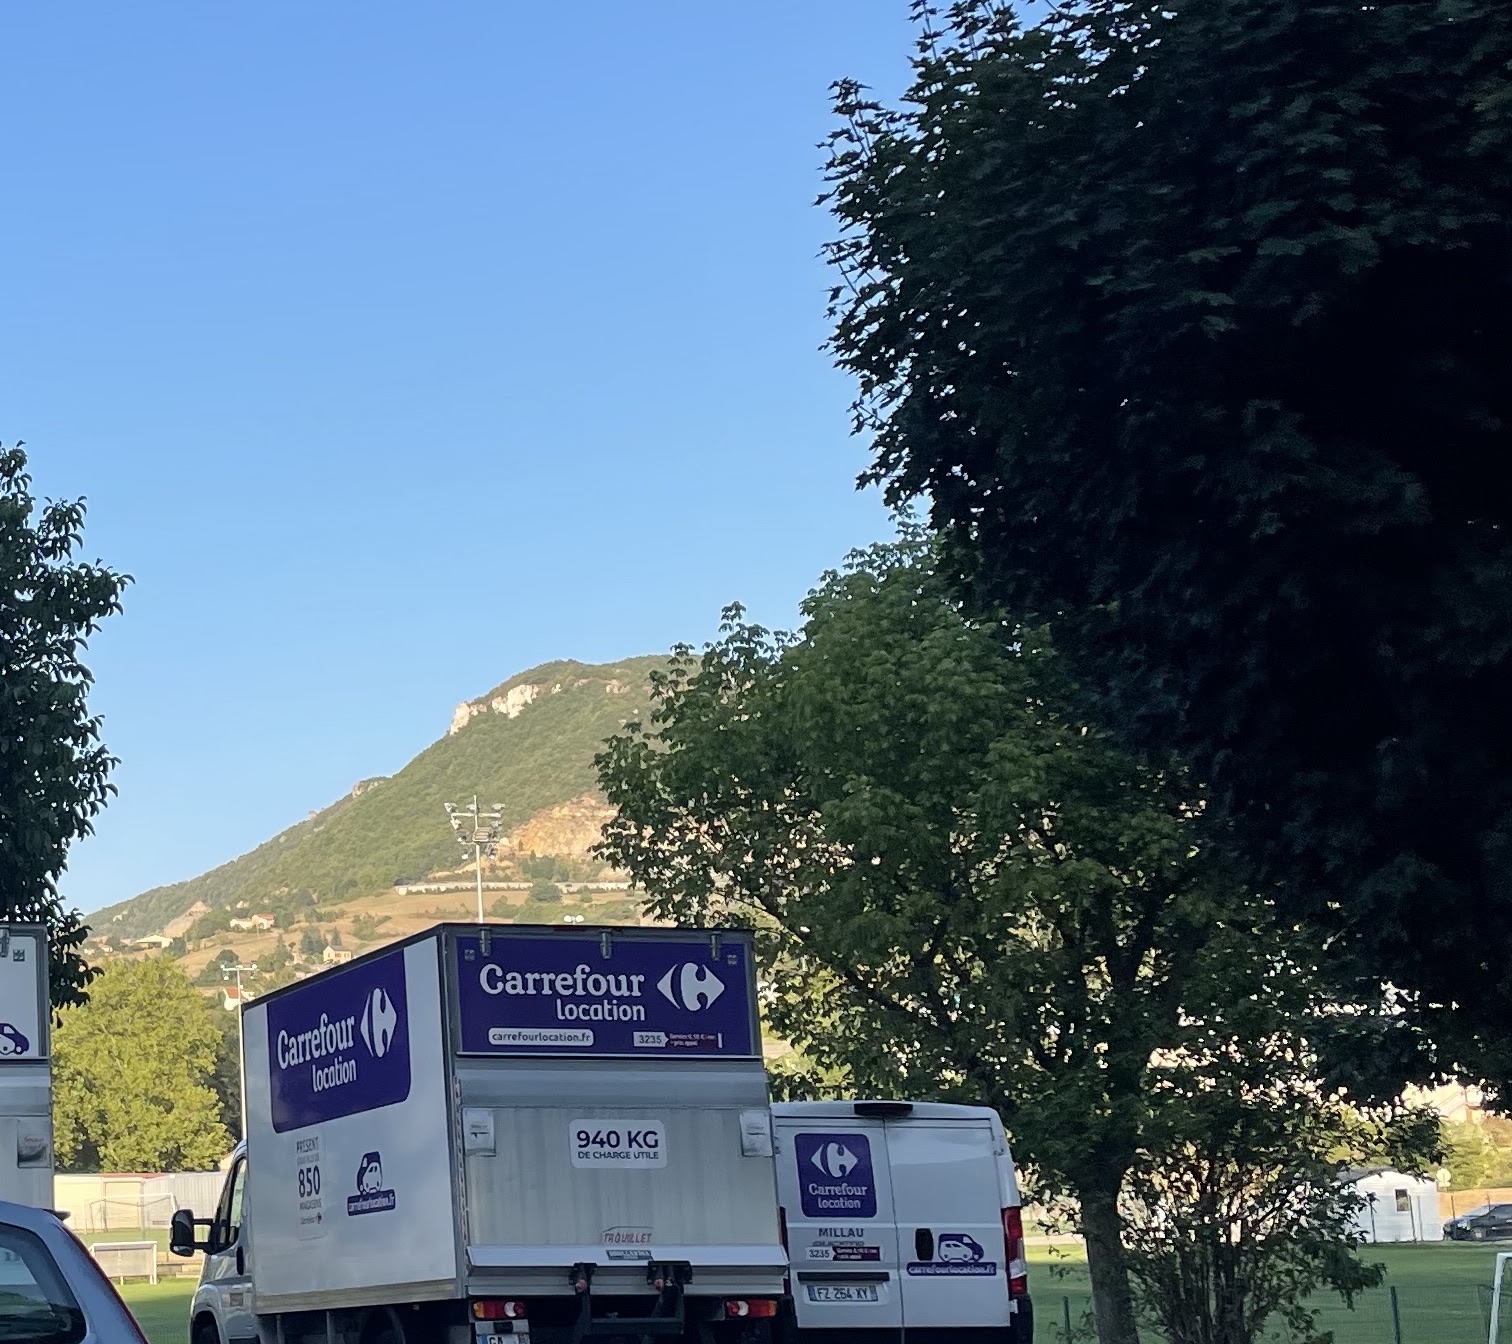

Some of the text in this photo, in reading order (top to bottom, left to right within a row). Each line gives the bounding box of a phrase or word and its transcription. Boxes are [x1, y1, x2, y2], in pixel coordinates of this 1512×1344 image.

[479, 963, 645, 997] Carrefour
[556, 998, 645, 1021] location
[277, 1012, 355, 1070] Carrefour
[492, 1031, 591, 1042] carrefourlocation.fr
[638, 1034, 662, 1045] 3235
[312, 1055, 357, 1093] location
[576, 1130, 659, 1149] 940 KG
[577, 1151, 659, 1159] DE CHARGE UTILE
[298, 1165, 320, 1198] 850
[808, 1182, 868, 1196] Carrefour
[818, 1197, 861, 1209] location
[818, 1227, 865, 1238] MILLAU
[809, 1249, 830, 1258] 3235
